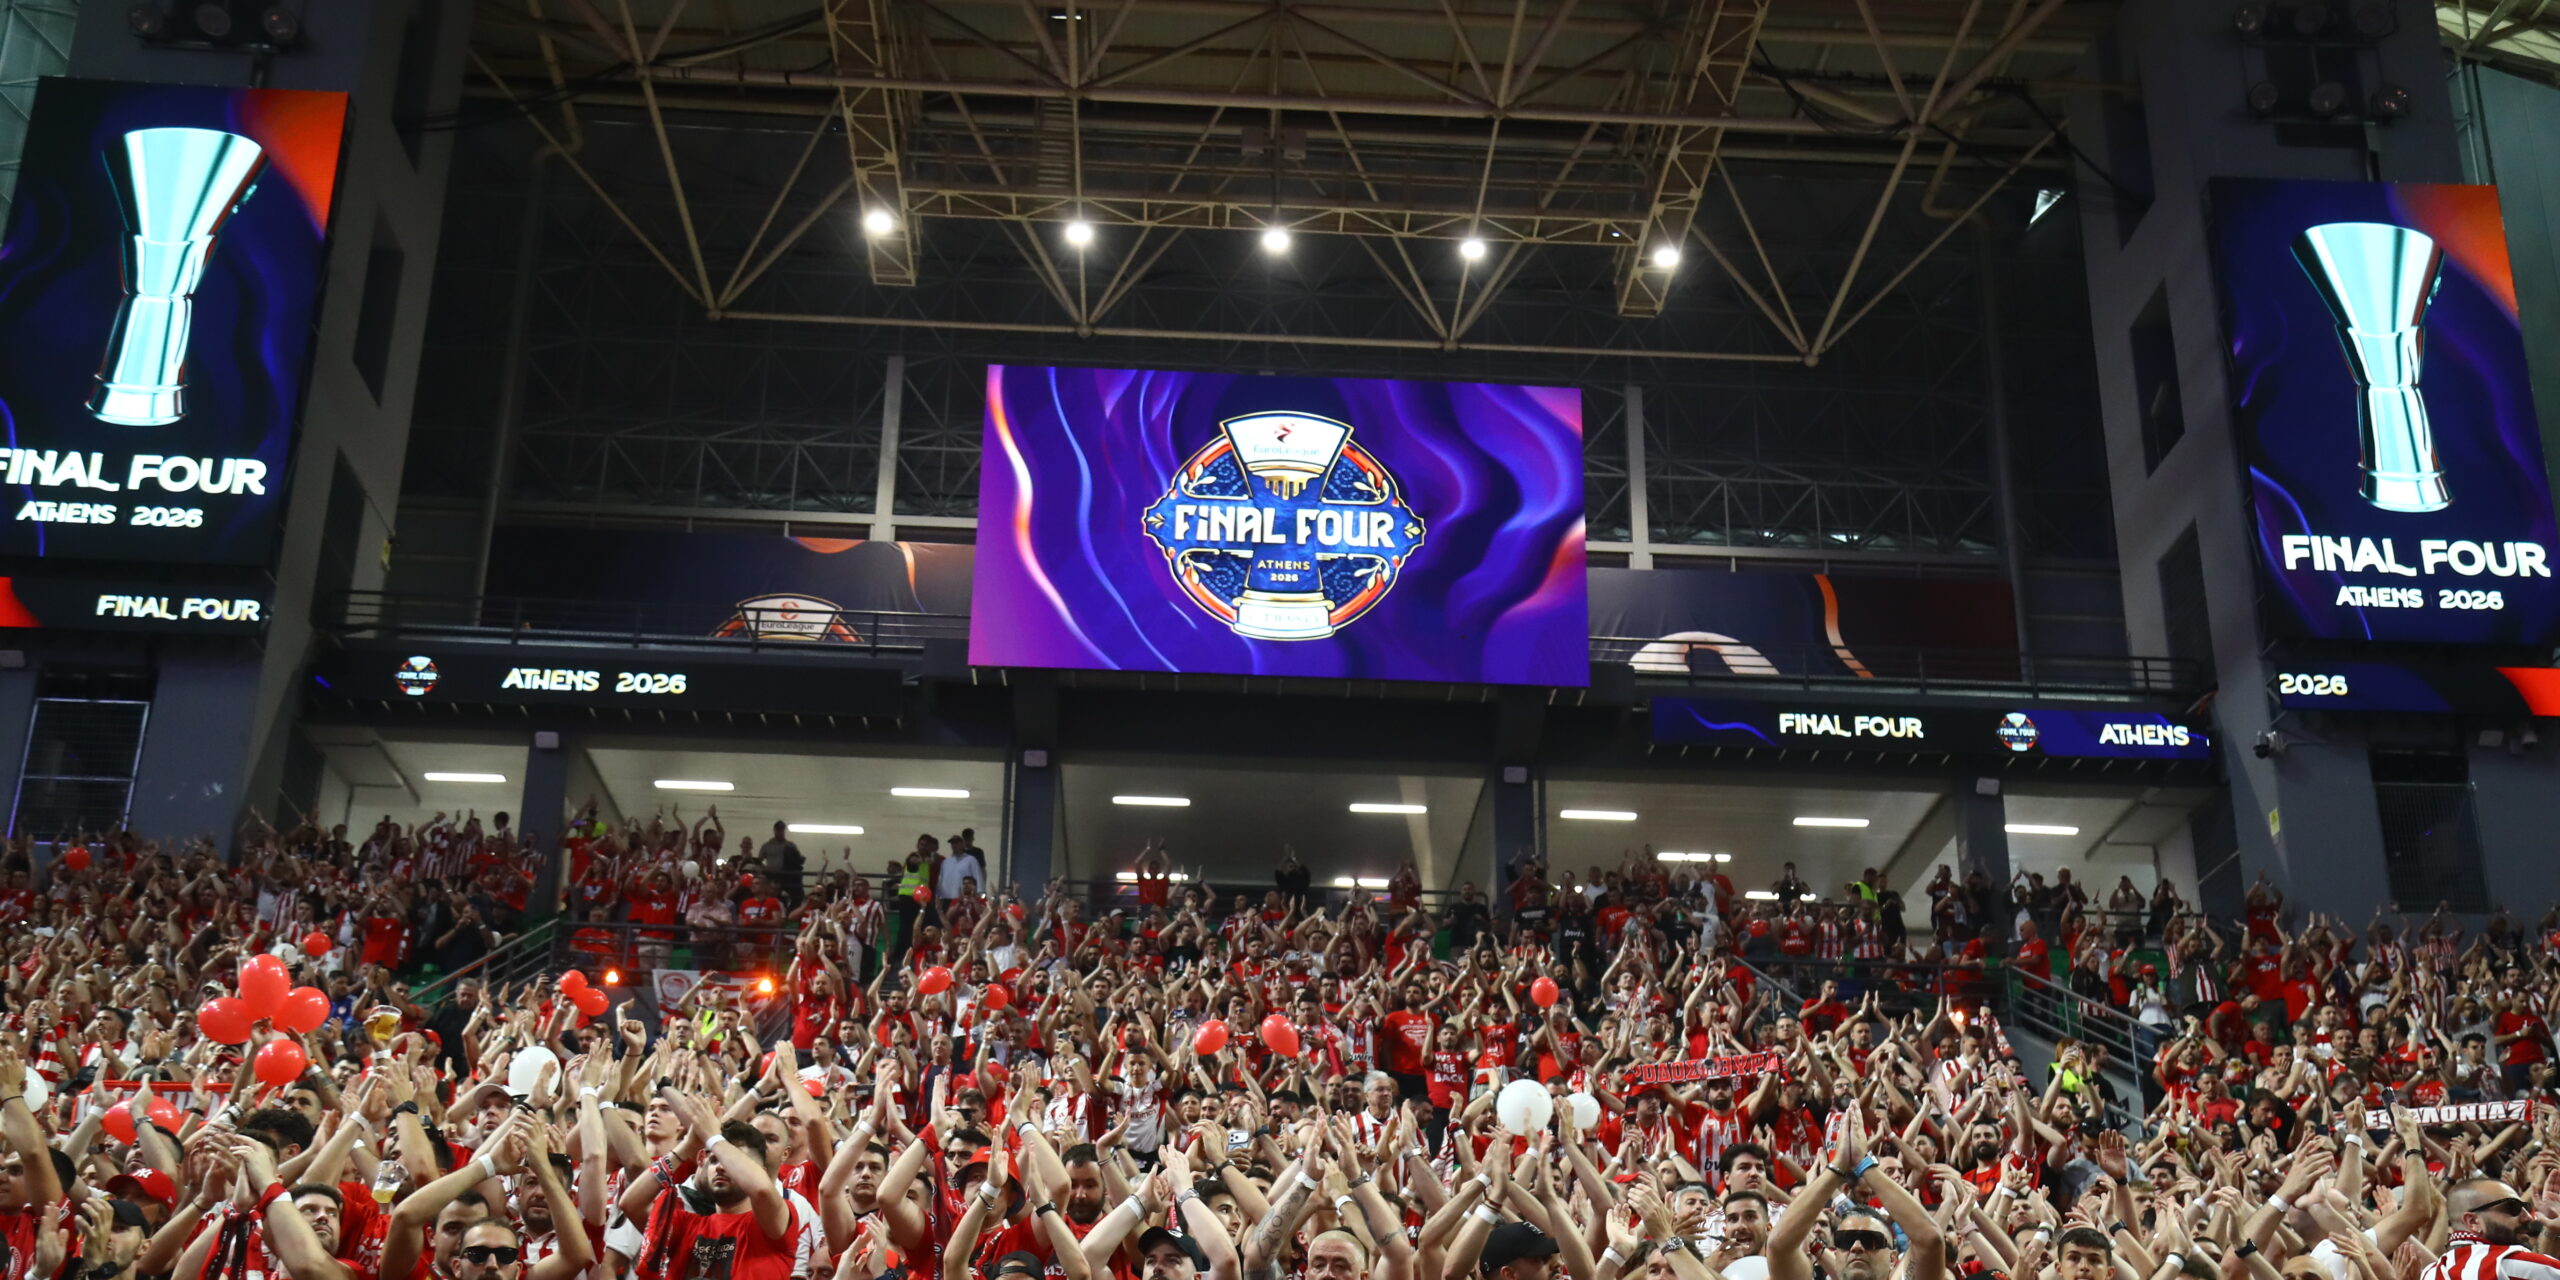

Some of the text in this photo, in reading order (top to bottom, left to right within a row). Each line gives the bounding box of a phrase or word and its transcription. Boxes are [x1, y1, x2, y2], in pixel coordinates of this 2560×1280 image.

[127, 454, 267, 496] FOUR
[16, 500, 204, 528] ATHENS 2026
[1174, 504, 1396, 548] FINAL FOUR
[1257, 559, 1311, 571] ATHENS
[2282, 534, 2552, 578] FINAL FOUR
[1270, 572, 1299, 582] 2026
[96, 594, 261, 622] FINAL FOUR
[2335, 585, 2505, 611] ATHENS 2026
[761, 621, 815, 631] EuroLeague
[501, 667, 687, 694] ATHENS 2026
[2278, 673, 2348, 696] 2026
[1779, 713, 1924, 739] FINAL FOUR
[2099, 723, 2190, 746] ATHENS
[1434, 1053, 1451, 1063] WE
[1435, 1063, 1456, 1073] ARE
[1434, 1072, 1465, 1083] BACK
